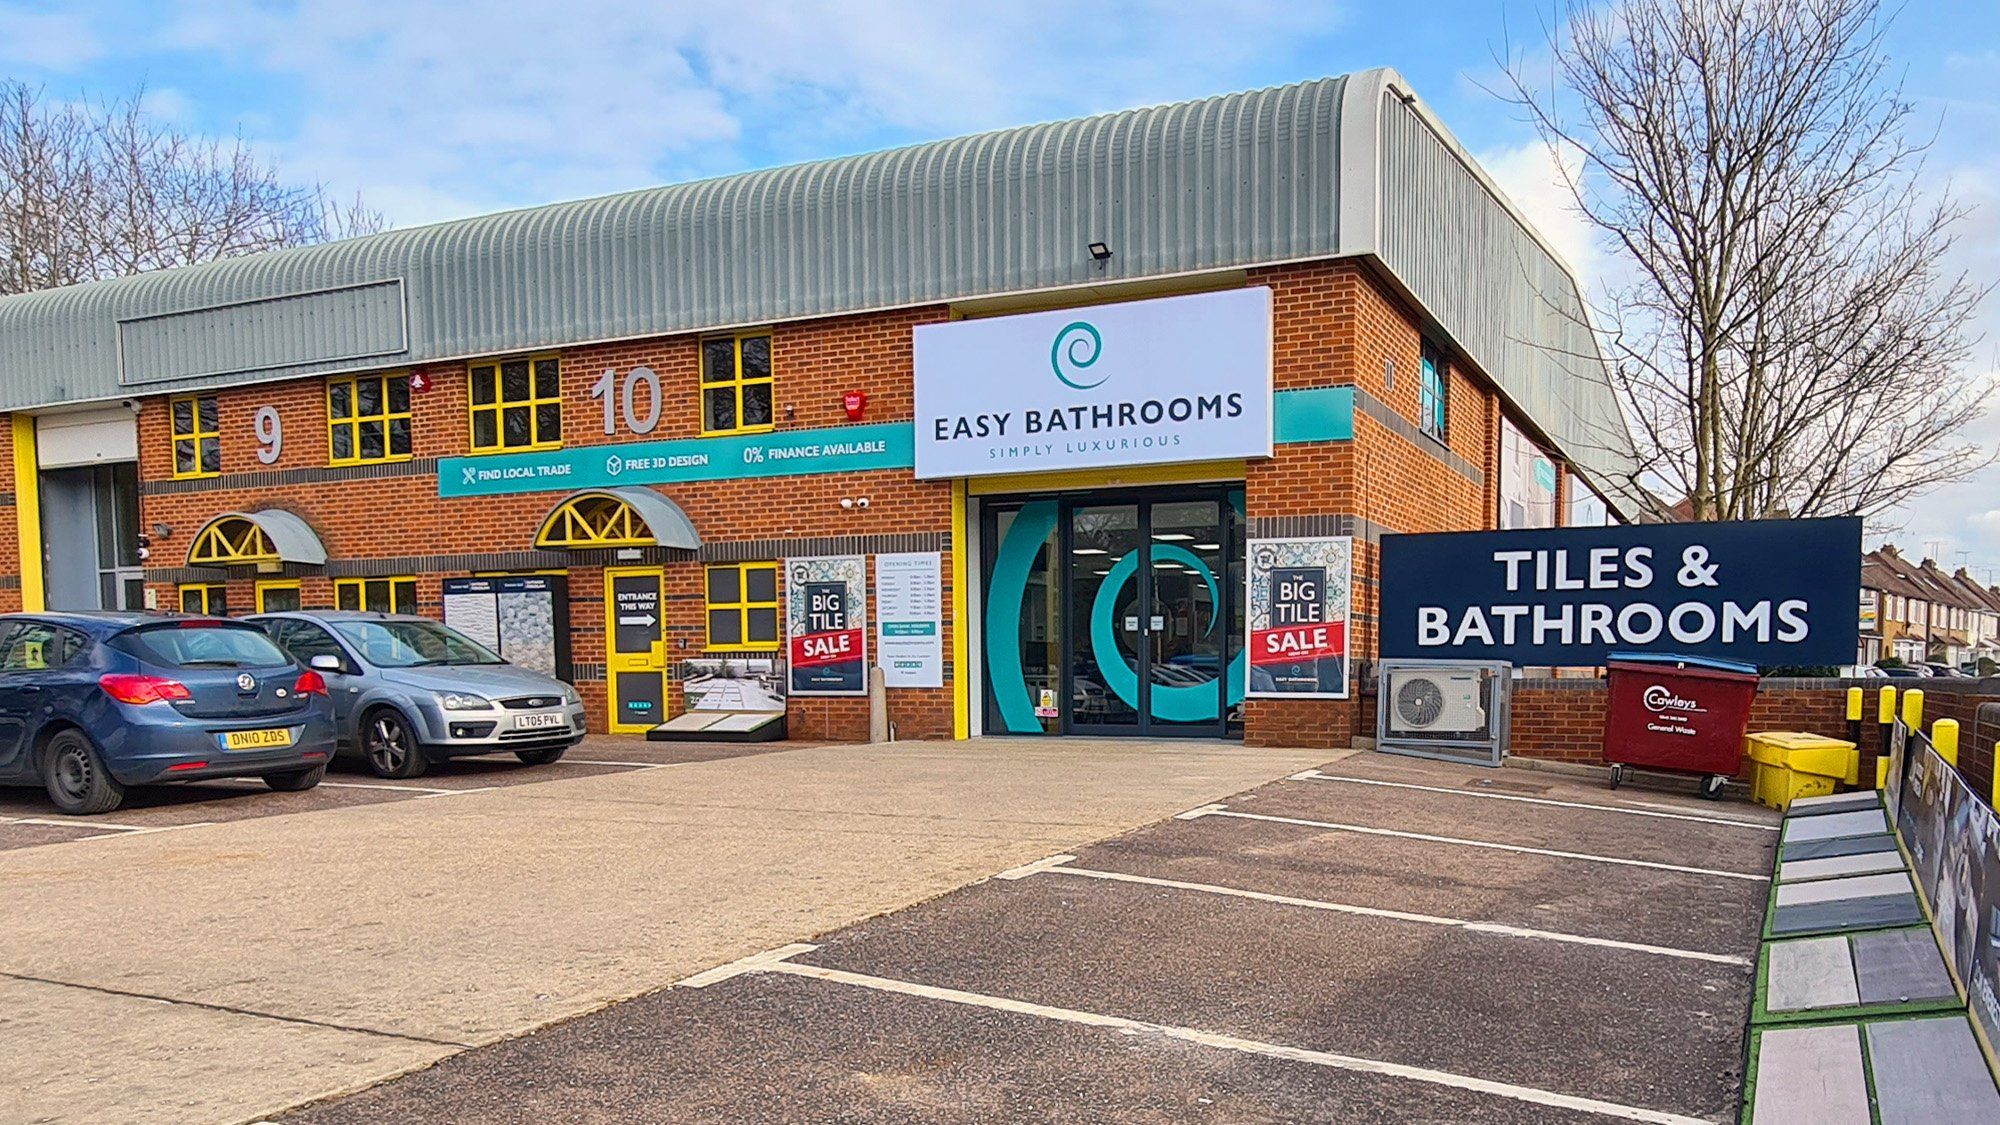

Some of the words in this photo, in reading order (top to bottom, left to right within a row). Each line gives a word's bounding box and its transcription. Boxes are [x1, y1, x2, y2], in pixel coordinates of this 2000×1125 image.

[591, 366, 662, 435] 10
[935, 412, 1011, 441] EASY
[1026, 392, 1243, 434] BATHROOMS
[254, 405, 283, 465] 9
[743, 446, 764, 464] 0%
[768, 445, 820, 460] FINANCE
[822, 440, 886, 456] AVAILABLE
[989, 444, 1053, 460] SIMPLY
[1066, 434, 1181, 454] LUXURIOUS
[478, 469, 501, 481] FIND
[503, 467, 536, 480] LOCAL
[538, 464, 572, 477] TRADE
[625, 457, 650, 470] FREE
[652, 456, 667, 469] 3D
[668, 454, 708, 468] DESIGN
[1494, 545, 1654, 592] TILES
[1676, 544, 1720, 588] &
[617, 592, 657, 602] ENTRANCE
[1280, 581, 1315, 601] BIG
[620, 603, 637, 611] THIS
[638, 602, 655, 610] WAY
[812, 594, 840, 612] BIG
[1276, 603, 1320, 623] TILE
[809, 612, 844, 630] TILE
[1417, 599, 1809, 647] BATHROOMS
[803, 634, 851, 657] SALE
[1266, 628, 1328, 654] SALE
[519, 715, 542, 727] LT05
[544, 715, 560, 726] PVL
